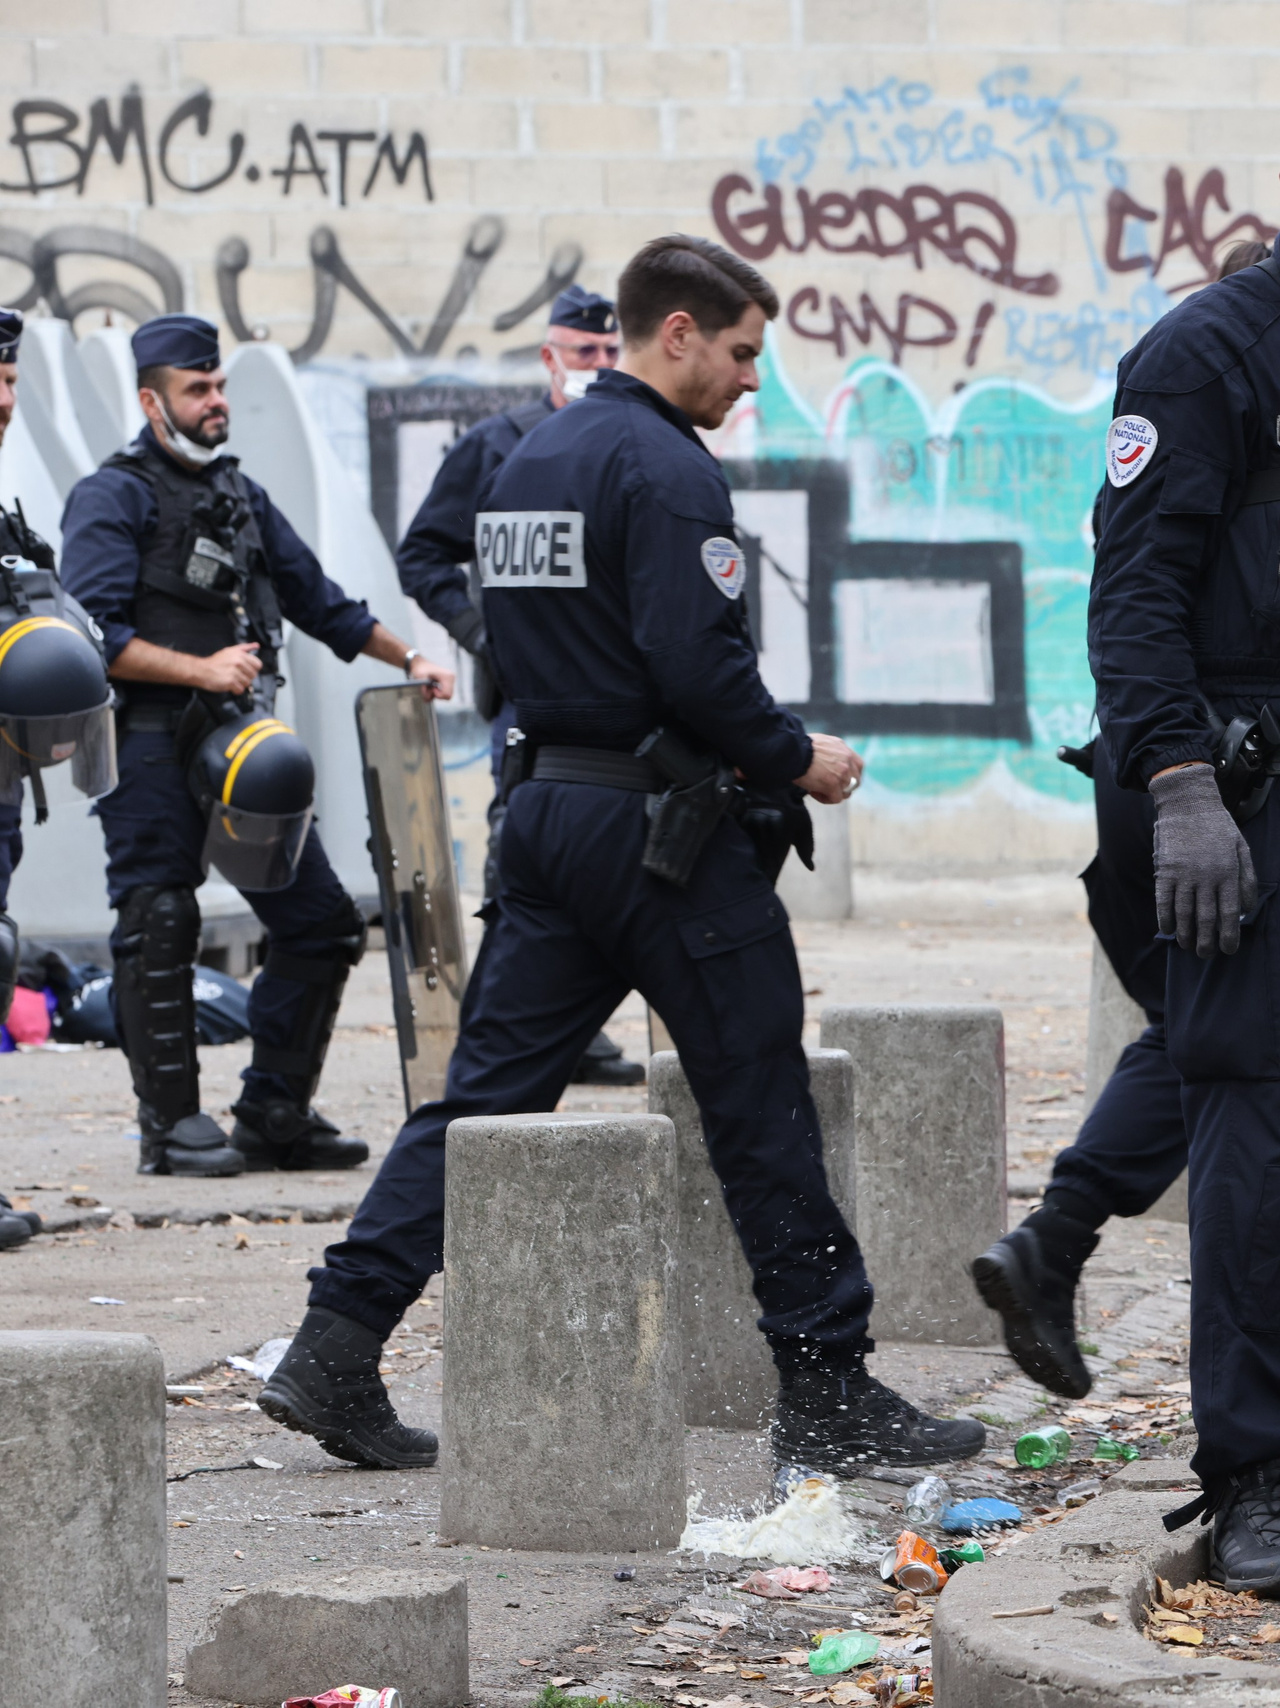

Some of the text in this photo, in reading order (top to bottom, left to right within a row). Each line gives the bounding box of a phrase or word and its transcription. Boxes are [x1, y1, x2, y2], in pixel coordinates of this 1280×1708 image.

[1124, 421, 1147, 433] POLICE
[1114, 428, 1152, 445] NATIONALE
[481, 521, 572, 577] POLICE
